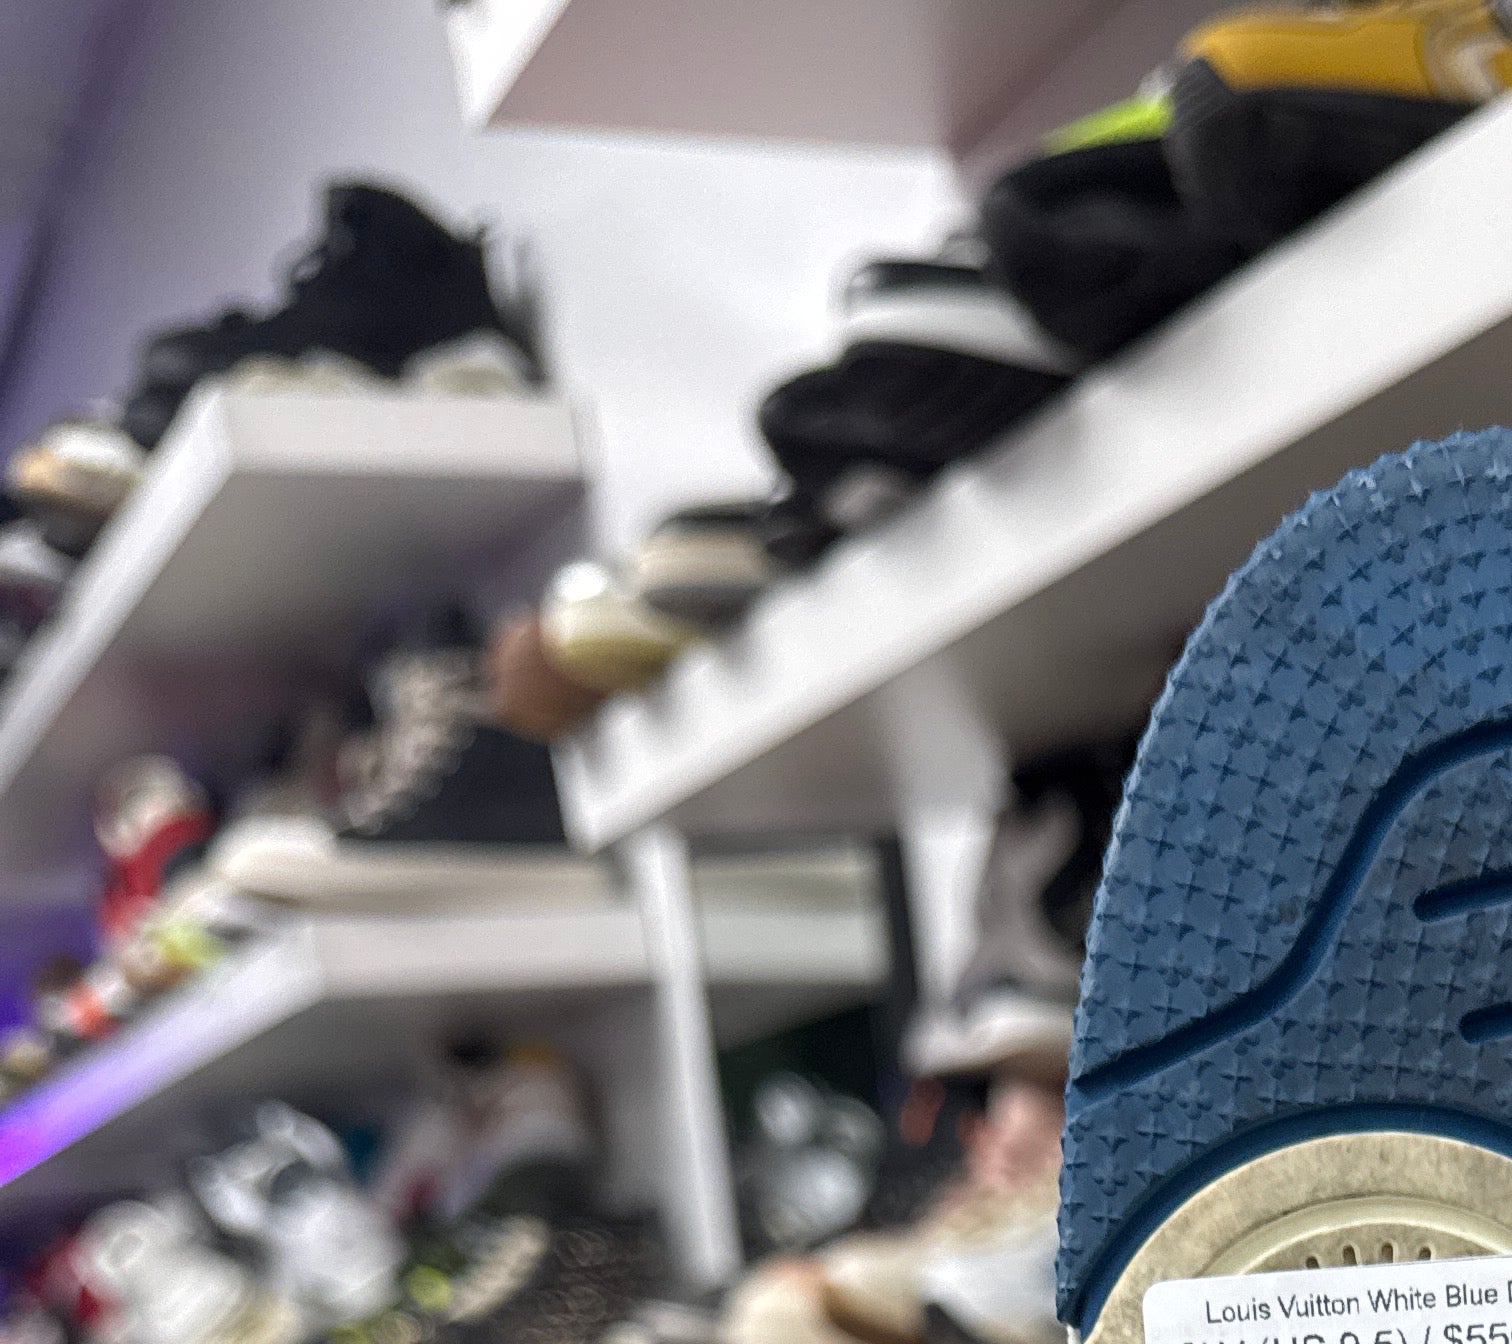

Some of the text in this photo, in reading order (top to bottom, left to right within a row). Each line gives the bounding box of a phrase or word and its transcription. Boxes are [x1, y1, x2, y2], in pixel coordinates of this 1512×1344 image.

[1205, 1300, 1271, 1324] Louis
[1277, 1293, 1360, 1319] Vuitton
[1367, 1289, 1436, 1313] White
[1445, 1283, 1499, 1308] Blue
